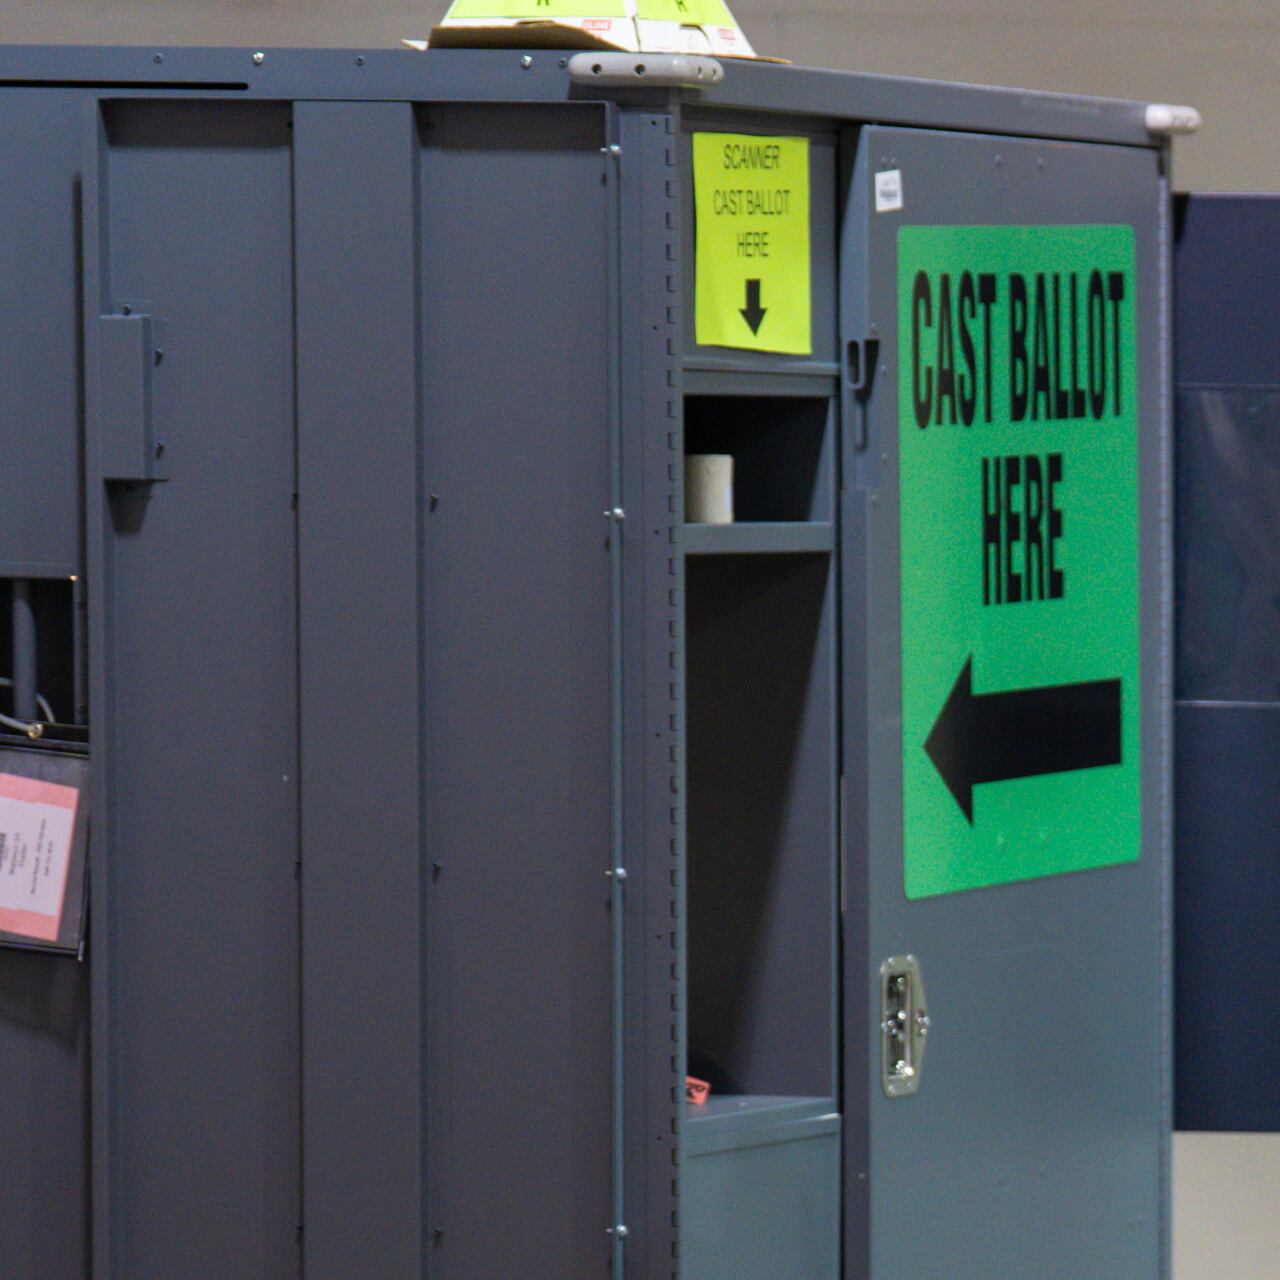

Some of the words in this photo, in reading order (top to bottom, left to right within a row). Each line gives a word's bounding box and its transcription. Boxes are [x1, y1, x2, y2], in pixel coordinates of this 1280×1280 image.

[723, 144, 780, 169] SCANNER
[713, 189, 743, 215] CAST
[746, 189, 790, 215] BALLOT
[736, 231, 769, 257] HERE
[911, 269, 996, 430] CAST
[1009, 268, 1124, 421] BALLOT
[981, 453, 1064, 606] HERE
